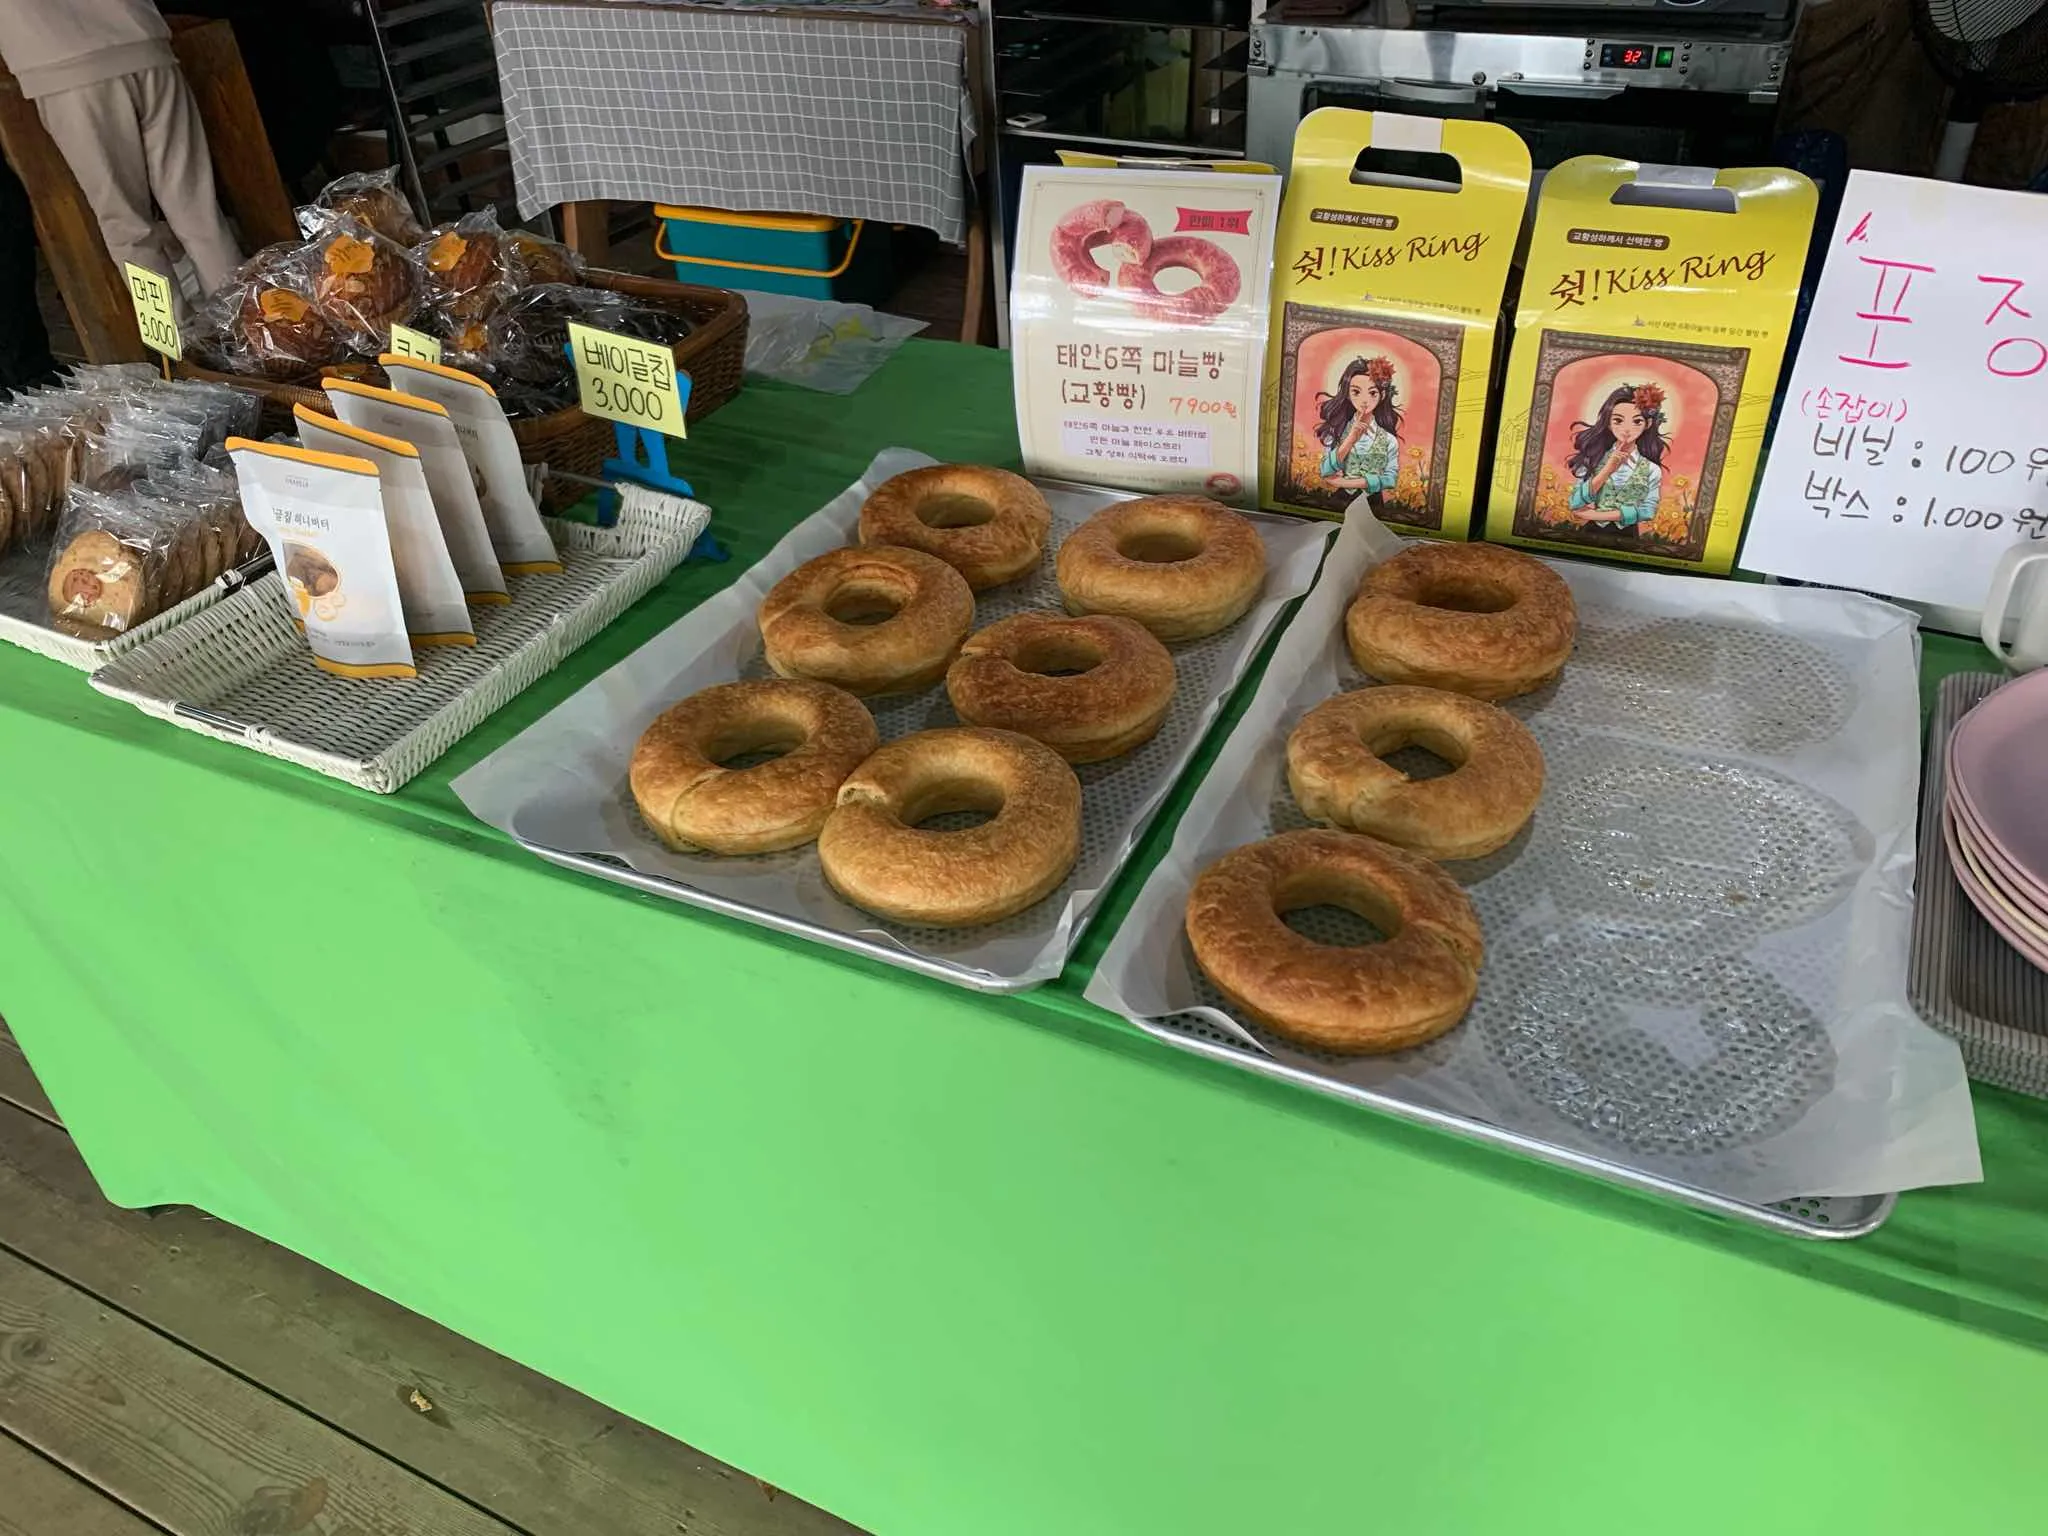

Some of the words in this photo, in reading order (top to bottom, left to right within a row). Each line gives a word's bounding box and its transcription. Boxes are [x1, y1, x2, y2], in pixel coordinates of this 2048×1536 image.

[1624, 50, 1642, 63] 32
[1292, 247, 1337, 285] 쉿!
[1342, 245, 1402, 270] Kiss
[1406, 231, 1490, 262] Ring
[1626, 234, 1652, 248] 선택한
[132, 276, 166, 314] 머핀
[1550, 269, 1600, 311] 쉿!
[1606, 266, 1675, 295] Kiss
[1680, 249, 1776, 284] Ring
[582, 336, 671, 391] 베이글칩
[1056, 343, 1143, 374] 태안6쪽
[1153, 350, 1225, 379] 마늘빵
[592, 377, 663, 421] 3,000
[1062, 379, 1146, 410] (교황빵)
[1801, 386, 1908, 423] (손잡이)
[1813, 422, 1895, 466] 비닐
[1804, 470, 1870, 519] 박스
